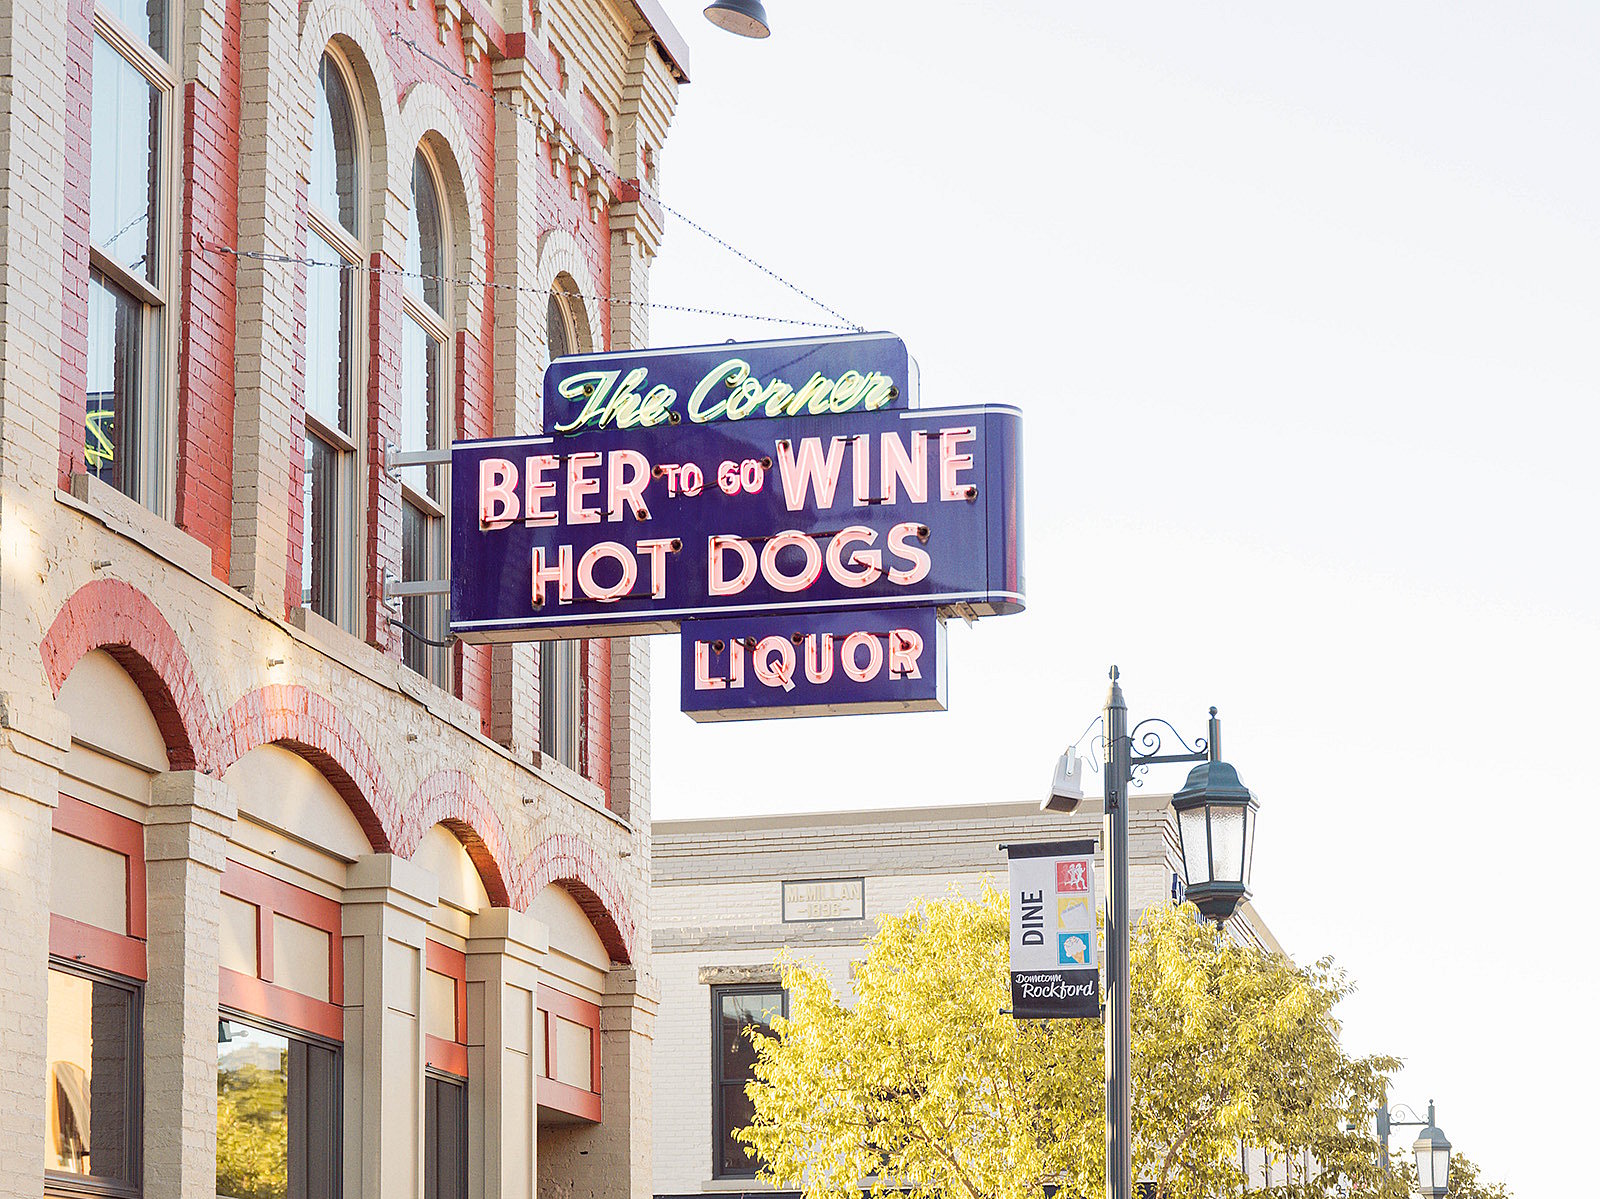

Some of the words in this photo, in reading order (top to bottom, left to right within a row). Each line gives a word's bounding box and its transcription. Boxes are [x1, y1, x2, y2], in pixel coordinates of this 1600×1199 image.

[554, 366, 678, 433] The
[688, 358, 893, 422] Corner
[478, 449, 653, 531] BEER
[662, 461, 703, 498] TO
[717, 459, 766, 496] GO
[775, 426, 977, 512] WINE
[531, 538, 675, 606] HOT
[708, 522, 933, 597] DOGS
[694, 629, 923, 692] LIQUOR
[1021, 889, 1044, 946] DINE
[1015, 973, 1062, 985] Downtown
[1021, 980, 1094, 999] Rockford
